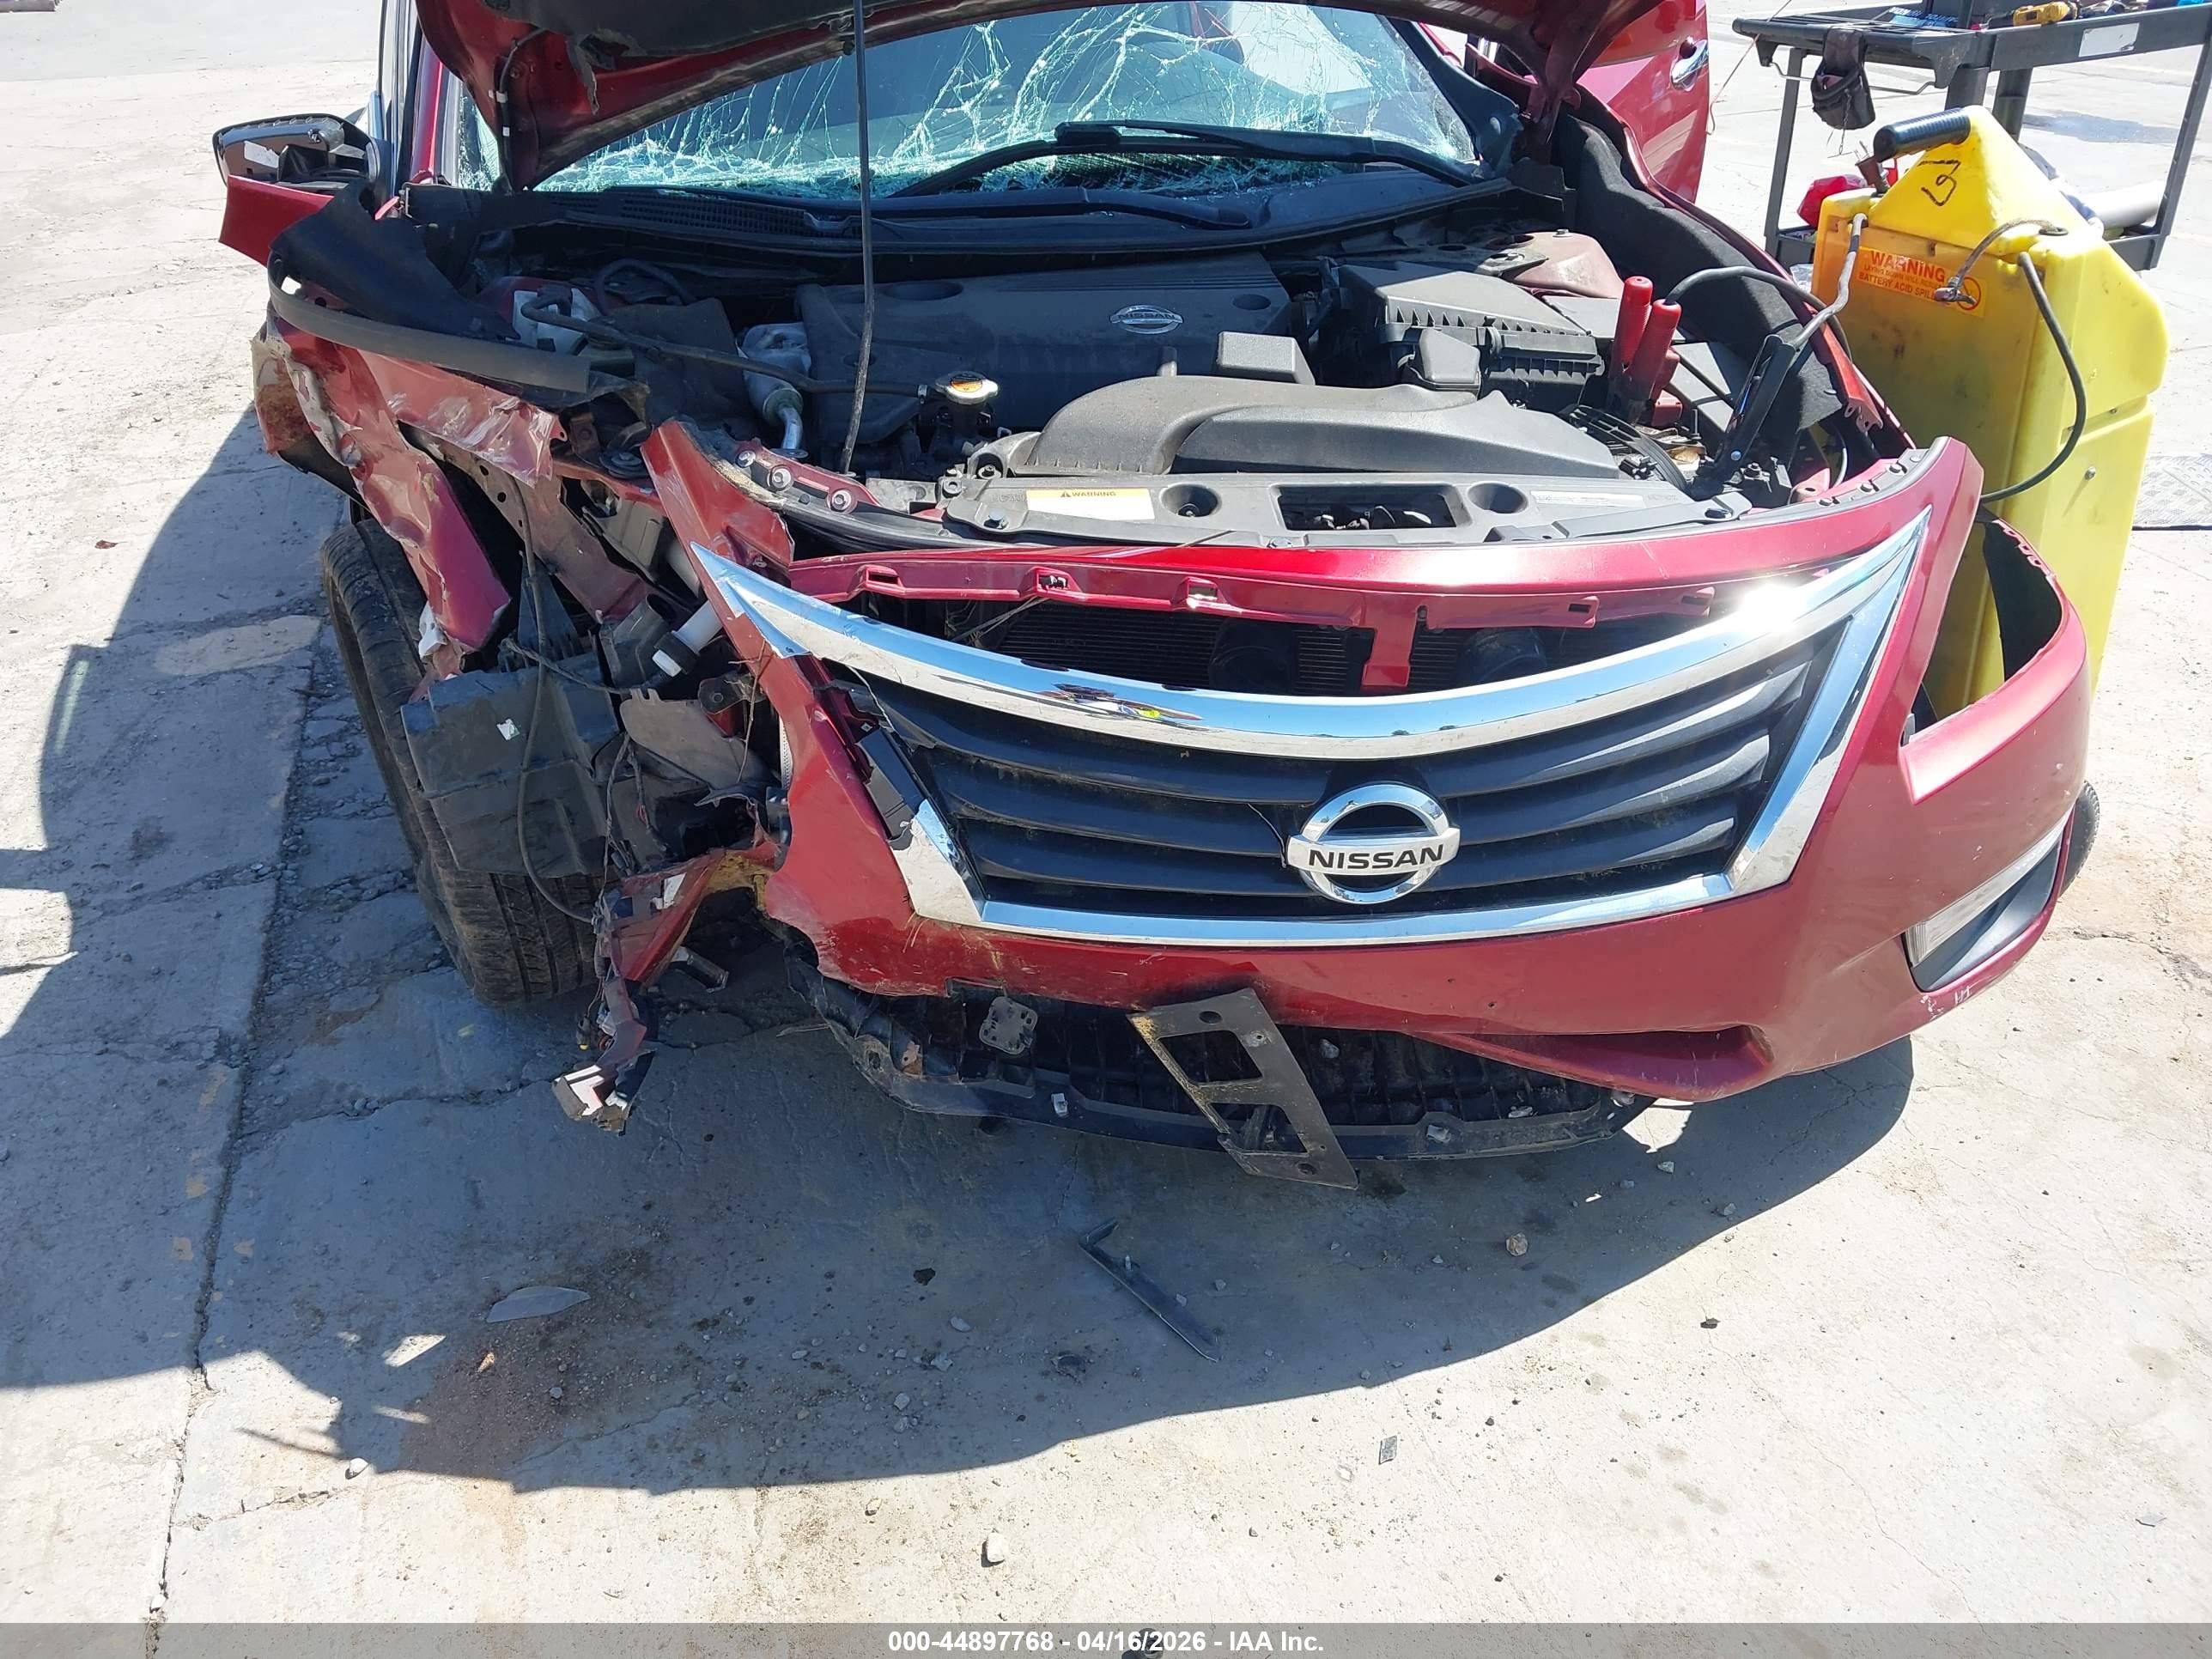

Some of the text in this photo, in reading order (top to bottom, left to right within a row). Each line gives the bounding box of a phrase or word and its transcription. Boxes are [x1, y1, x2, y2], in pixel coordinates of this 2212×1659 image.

[1870, 251, 1945, 283] WARNING
[1858, 271, 1893, 287] BATTERY
[1894, 281, 1913, 294] ACID
[1309, 844, 1444, 869] NISSAN
